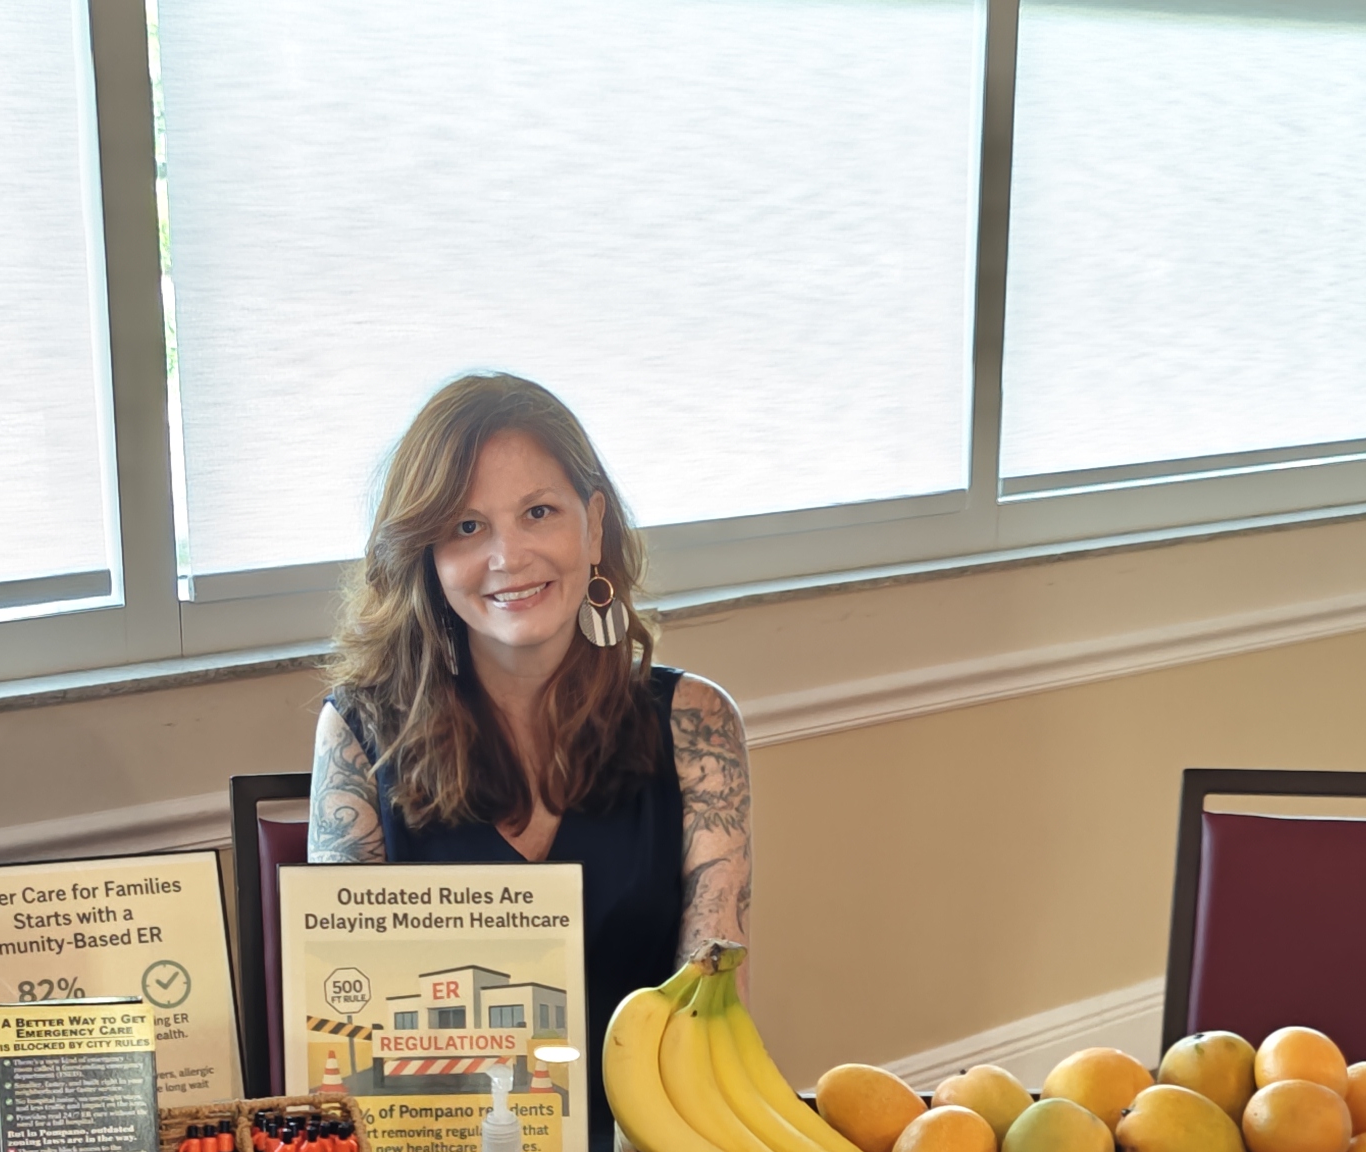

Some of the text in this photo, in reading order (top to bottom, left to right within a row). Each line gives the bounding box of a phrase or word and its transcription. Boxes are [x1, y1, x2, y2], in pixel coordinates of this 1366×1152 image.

[22, 887, 67, 904] Care
[72, 883, 99, 900] for
[104, 878, 182, 897] Families
[337, 887, 533, 905] Outdated Rules Are
[13, 907, 133, 929] Starts with a
[305, 912, 570, 933] Delaying Modern Healthcare
[137, 927, 163, 944] ER
[18, 976, 85, 1002] 82%
[332, 980, 363, 994] 500
[432, 981, 460, 999] ER
[344, 994, 367, 1003] RULE
[1, 1019, 11, 1028] A
[16, 1018, 64, 1028] BETTER
[68, 1016, 96, 1025] WAY
[121, 1015, 146, 1023] GET
[173, 1013, 189, 1024] ER
[16, 1026, 133, 1038] EMERGENCY CARE
[0, 1044, 10, 1052] IS
[14, 1042, 66, 1051] BLOCKED
[86, 1040, 112, 1048] CITY
[115, 1039, 150, 1047] RULES
[380, 1035, 516, 1051] REGULATIONS
[379, 1105, 474, 1121] of Pompano
[40, 1128, 89, 1138] Pompano,
[91, 1125, 135, 1134] outdated
[381, 1125, 549, 1140] removing that
[8, 1138, 41, 1147] zoning
[43, 1137, 66, 1145] laws
[115, 1135, 137, 1143] way.
